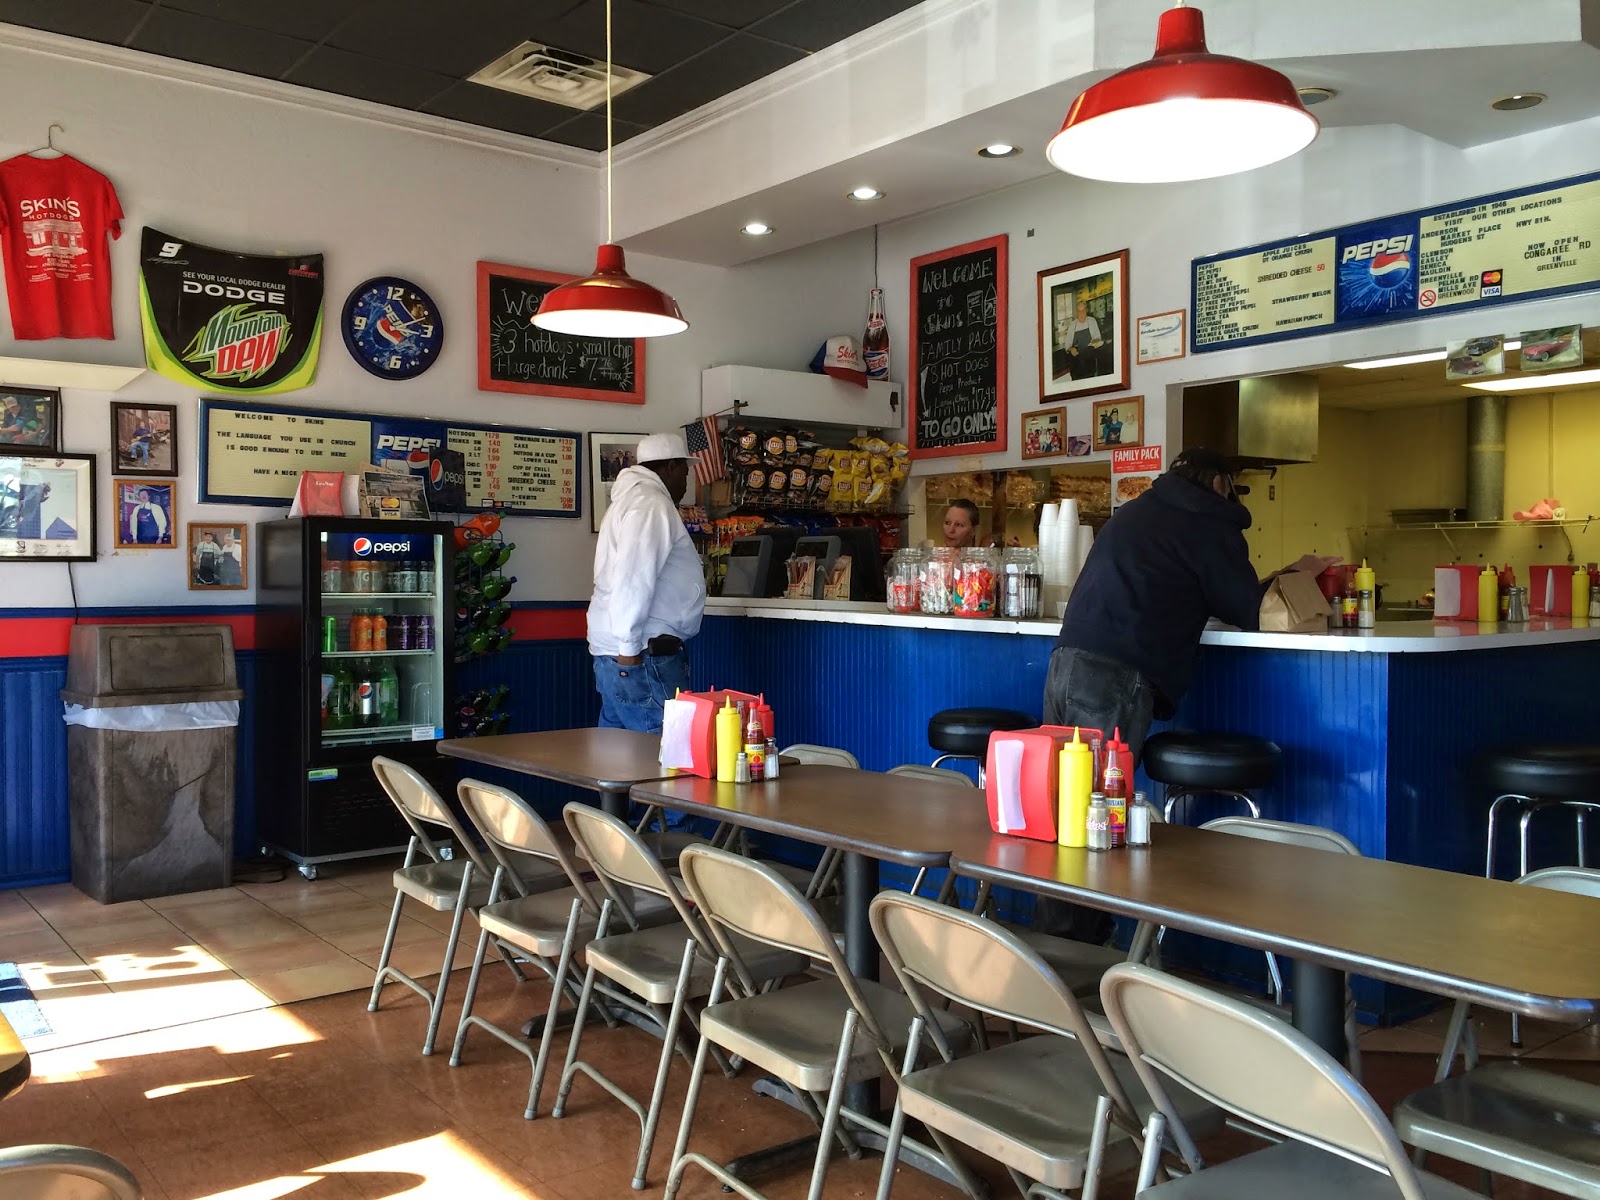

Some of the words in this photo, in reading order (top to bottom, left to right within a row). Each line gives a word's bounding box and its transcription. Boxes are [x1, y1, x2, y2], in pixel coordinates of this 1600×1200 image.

[1434, 208, 1476, 222] ESTABLISHED
[1492, 201, 1507, 209] 1946
[1444, 218, 1463, 227] VISIT
[1472, 212, 1487, 221] OUR
[1492, 206, 1516, 216] OTHER
[1520, 196, 1562, 211] LOCATIONS
[1420, 226, 1458, 239] ANDERSON
[1440, 230, 1471, 241] MARKET
[1478, 224, 1502, 233] PLACE
[1516, 219, 1532, 228] HWY
[1342, 234, 1414, 264] PEPSI
[1440, 236, 1472, 248] HUDGENS
[1528, 242, 1546, 251] NOW
[1554, 236, 1579, 246] OPEN
[159, 242, 183, 258] 9
[1262, 248, 1281, 257] APPLE
[1282, 244, 1306, 252] JUICES
[1271, 252, 1292, 262] ORANGE
[1420, 248, 1454, 258] CLEMSON
[1524, 244, 1570, 260] CONGAREE
[1579, 240, 1591, 250] RD
[1420, 254, 1449, 264] EASLEY
[1420, 261, 1446, 270] SENECA
[1537, 258, 1578, 272] GREENVILLE
[1258, 271, 1288, 283] SHREDDED
[1290, 266, 1312, 276] CHEESE
[1420, 266, 1451, 276] MAULDIN
[1420, 271, 1463, 284] GREENVILLE
[182, 271, 196, 279] SEE
[197, 272, 216, 282] YOUR
[216, 275, 237, 284] LOCAL
[238, 278, 261, 288] DODGE
[262, 281, 286, 290] DEALER
[1438, 277, 1466, 286] PELHAM
[182, 280, 285, 304] DODGE
[386, 286, 404, 300] 12
[1272, 293, 1310, 304] STRAWBERRY
[1312, 289, 1332, 298] MELON
[1438, 286, 1458, 294] MILLS
[1438, 288, 1474, 300] GREENWOOD
[1483, 288, 1500, 296] VISA
[354, 316, 368, 330] 9
[1303, 314, 1323, 322] PUNCH
[420, 324, 434, 338] 3
[502, 328, 518, 354] 3
[920, 336, 962, 364] FAMILY
[968, 328, 996, 350] PACK
[390, 355, 402, 369] 6
[940, 362, 960, 380] HOT
[965, 357, 988, 372] DOGS
[234, 412, 274, 422] WELCOME
[920, 420, 940, 438] TO
[940, 416, 960, 438] GO
[236, 432, 272, 440] LANGUAGE
[1114, 449, 1140, 462] FAMILY
[1140, 448, 1160, 460] PACK
[444, 470, 464, 486] pepsi
[374, 541, 410, 554] pepsi
